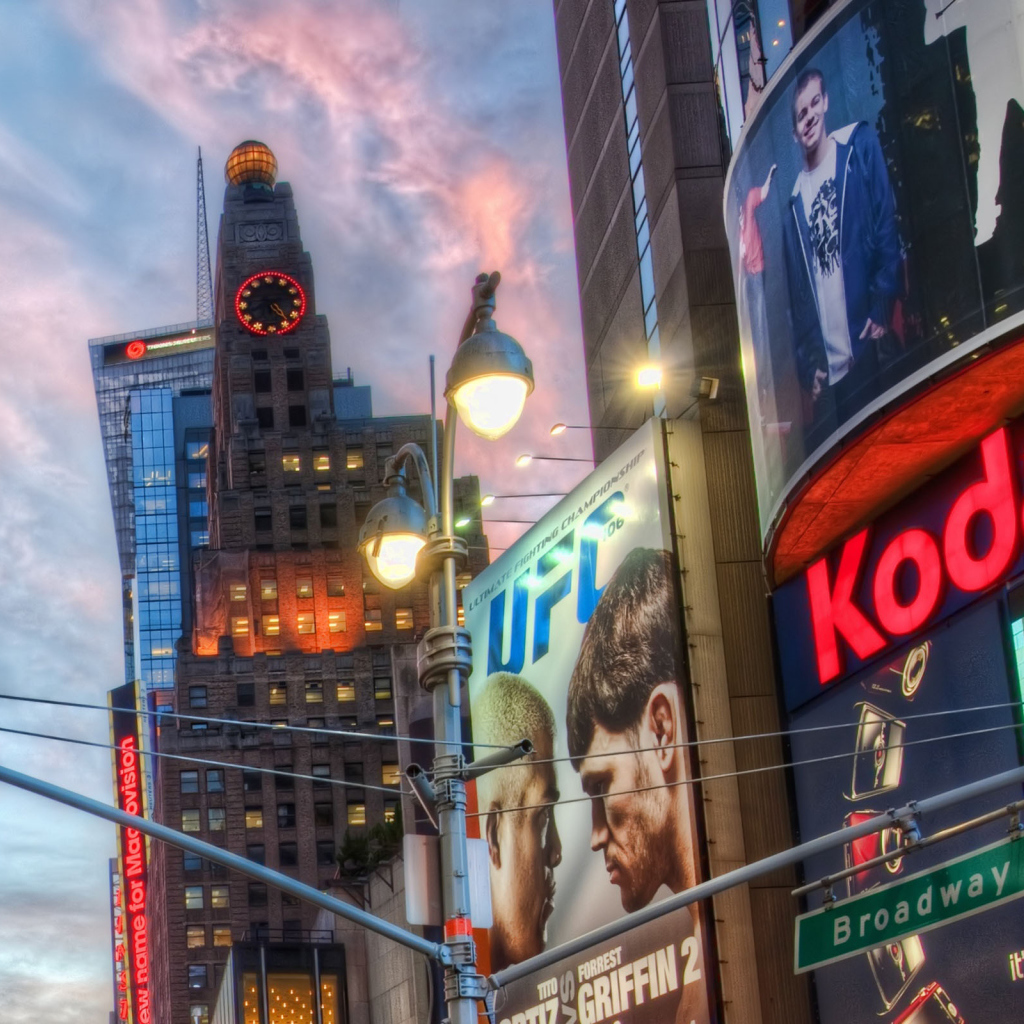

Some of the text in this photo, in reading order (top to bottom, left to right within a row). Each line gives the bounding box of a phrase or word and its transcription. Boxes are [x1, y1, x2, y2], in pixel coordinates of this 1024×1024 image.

[469, 450, 645, 612] ULTIMATE FIGHTING CHAMPIONSHIP
[603, 516, 625, 542] 06
[807, 427, 1024, 684] Kod
[487, 490, 625, 677] UFC
[120, 735, 143, 878] Macovision
[128, 880, 146, 913] for
[833, 861, 1010, 946] Broadway
[131, 914, 149, 985] name
[537, 977, 558, 1001] TITO
[578, 946, 622, 983] FORREST
[681, 936, 702, 986] 2
